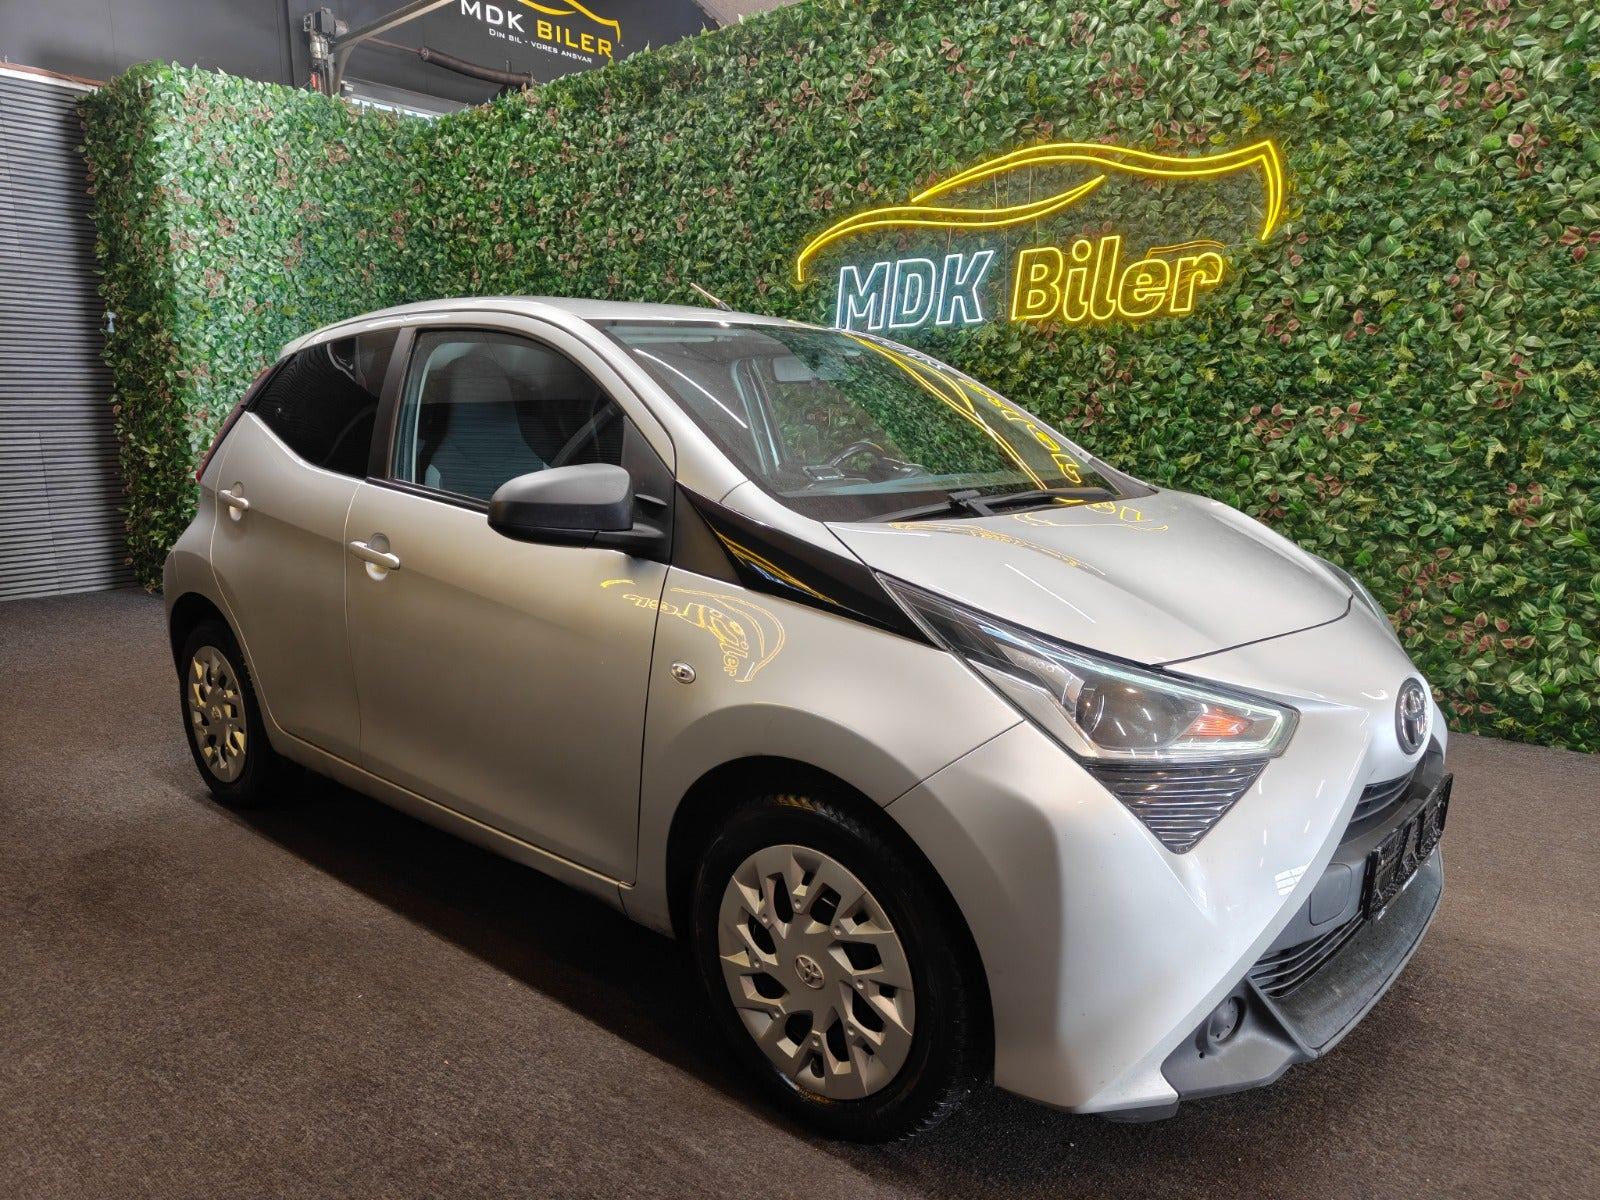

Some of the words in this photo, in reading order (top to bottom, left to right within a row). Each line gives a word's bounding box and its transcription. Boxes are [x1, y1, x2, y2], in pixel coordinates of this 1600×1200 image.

[461, 0, 525, 33] MDK
[536, 20, 613, 58] BILER
[489, 28, 506, 39] DIN
[508, 34, 522, 44] BIL
[531, 41, 558, 54] VORES
[561, 50, 593, 64] ANSVAR
[836, 249, 995, 331] MDK
[1012, 234, 1225, 322] Biler
